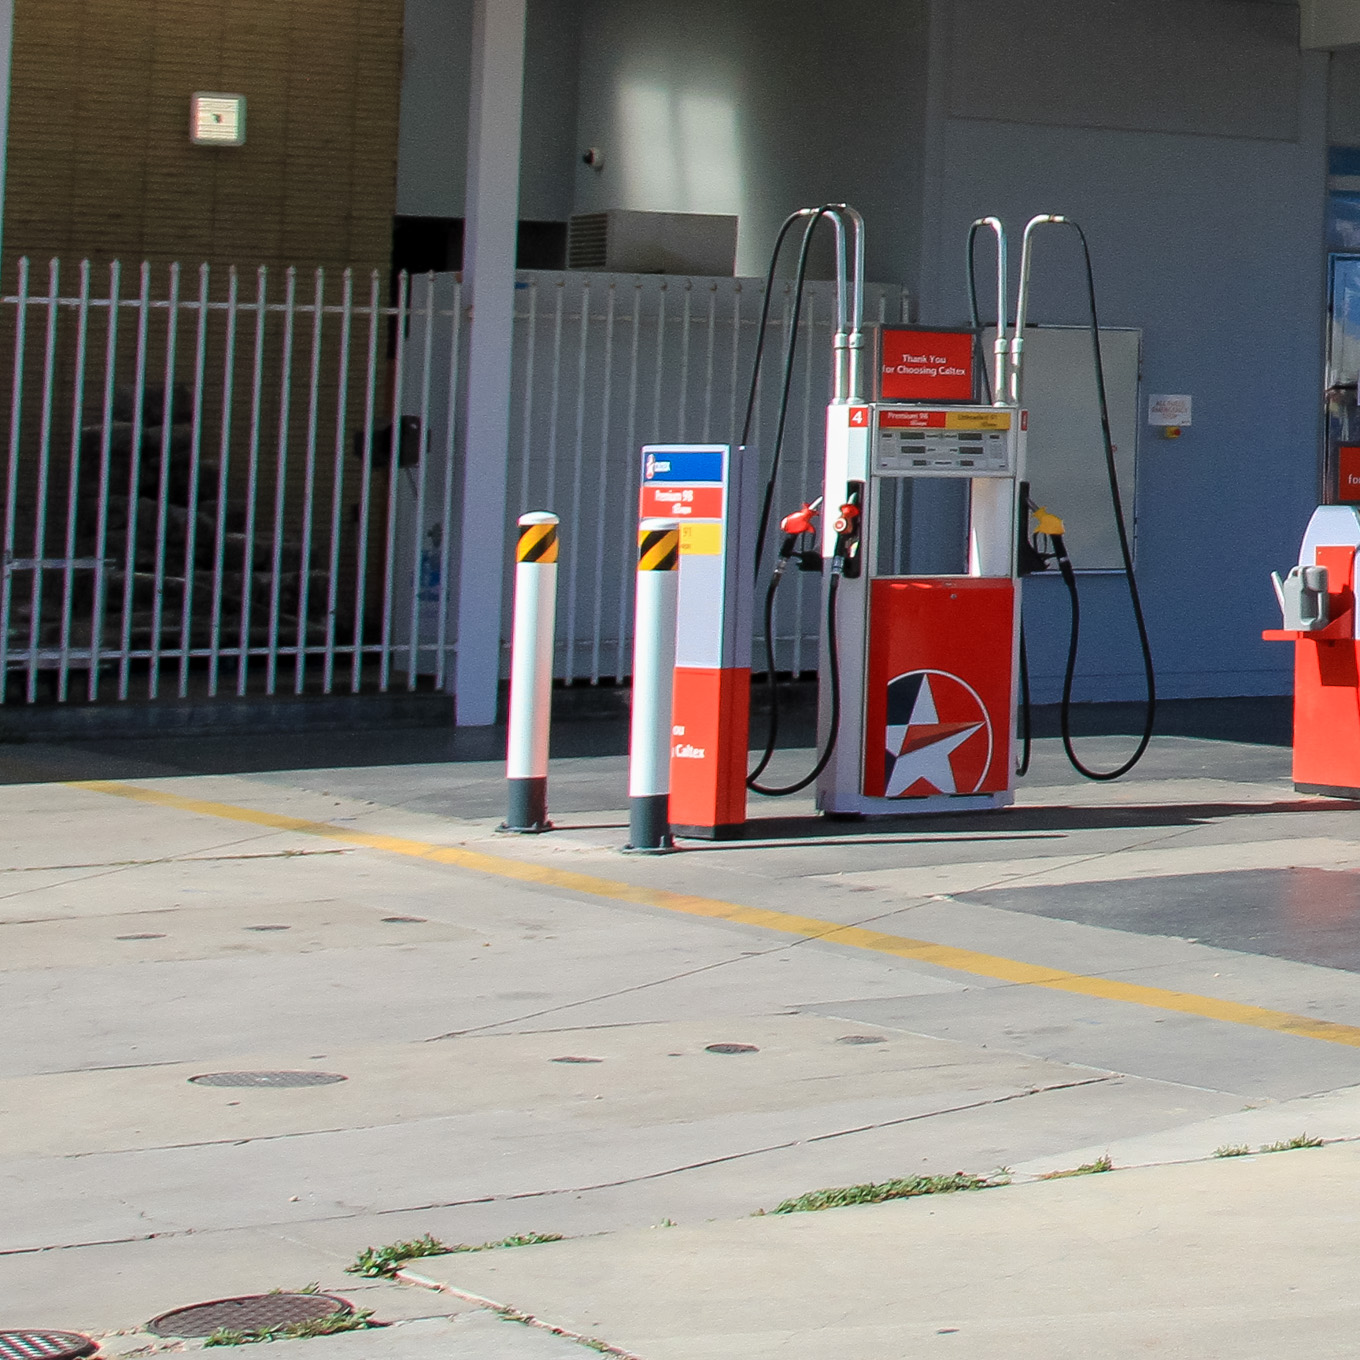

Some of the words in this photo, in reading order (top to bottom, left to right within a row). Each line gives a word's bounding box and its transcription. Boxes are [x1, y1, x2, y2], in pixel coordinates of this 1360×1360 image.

[902, 354, 927, 364] Thank
[929, 355, 946, 364] You
[882, 365, 895, 373] for
[897, 365, 937, 376] Choosing
[939, 367, 966, 376] Caltex
[852, 411, 863, 424] 4
[671, 725, 685, 736] ou
[676, 744, 705, 759] Caltex
